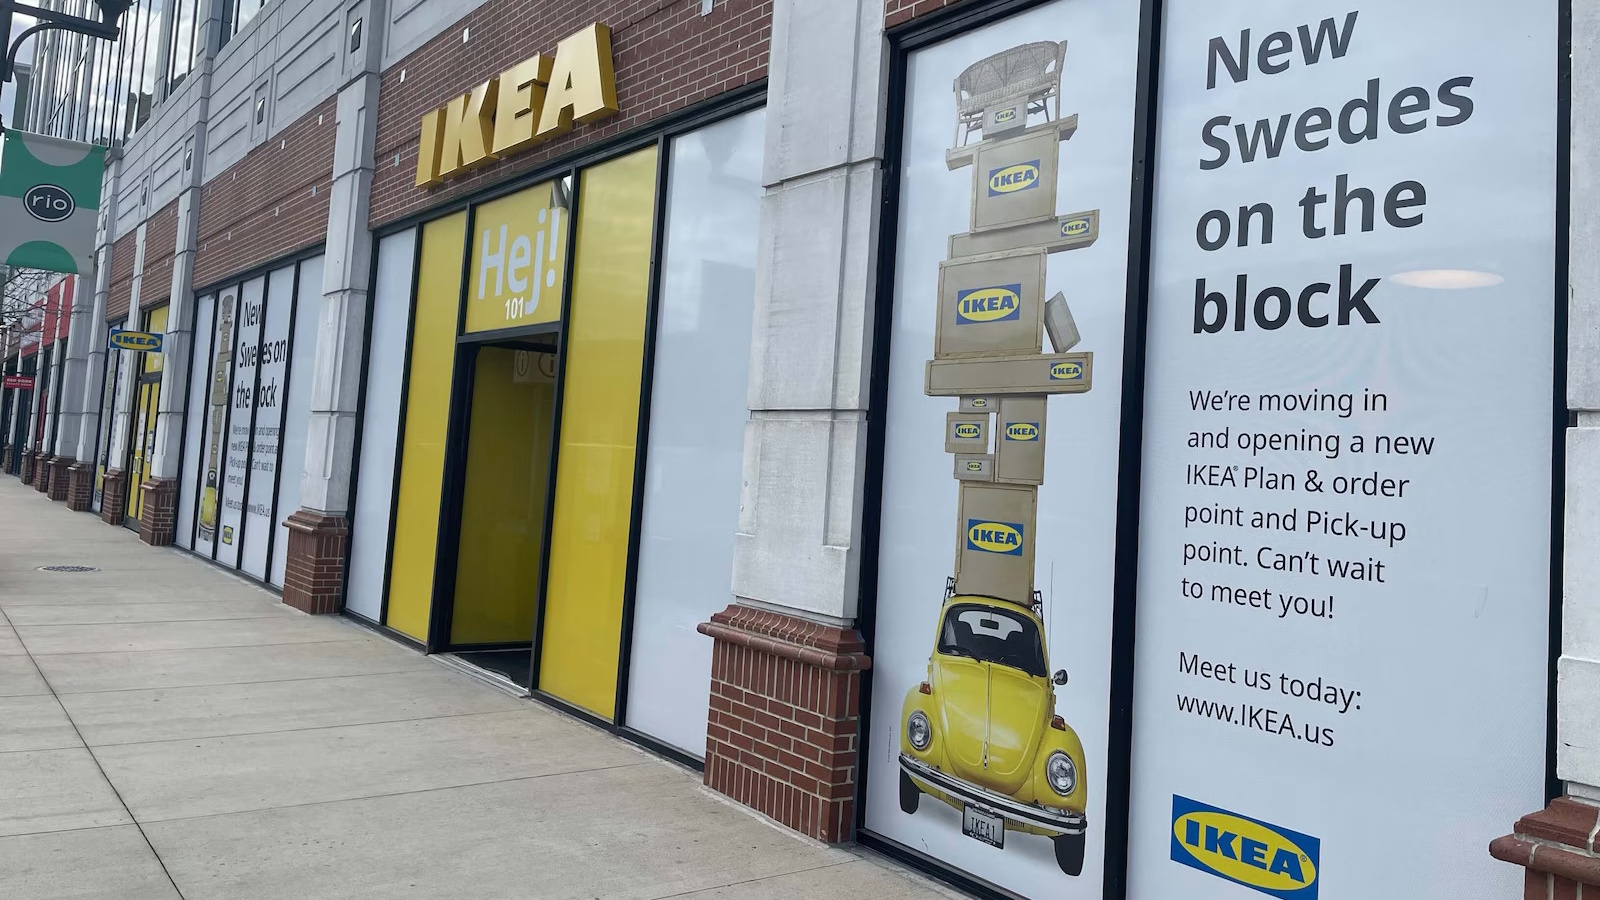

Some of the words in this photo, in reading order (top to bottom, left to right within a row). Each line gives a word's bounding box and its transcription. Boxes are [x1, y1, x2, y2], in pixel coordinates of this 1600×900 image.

[1206, 10, 1359, 90] New
[415, 22, 619, 188] IKEA
[997, 109, 1015, 120] IKEA
[1199, 76, 1474, 171] Swedes
[993, 168, 1035, 188] IKEA
[32, 194, 67, 211] rio
[1196, 202, 1274, 251] on
[1298, 173, 1427, 239] the
[1063, 222, 1087, 233] IKEA
[478, 208, 560, 315] Hej!
[505, 297, 524, 320] 101
[963, 294, 1015, 315] IKEA
[1193, 263, 1382, 334] block
[115, 335, 158, 347] IKEA
[240, 342, 273, 368] Swees
[274, 339, 286, 363] on
[1053, 366, 1080, 375] IKEA
[236, 381, 251, 409] the
[1189, 390, 1250, 411] We’re
[1259, 389, 1353, 418] moving
[1363, 388, 1387, 412] in
[957, 426, 979, 435] IKEA
[1008, 426, 1036, 436] IKEA
[1187, 427, 1229, 448] and
[1237, 429, 1340, 459] opening
[1350, 436, 1364, 453] a
[1375, 435, 1434, 455] new
[1244, 466, 1295, 491] Plan
[1304, 470, 1324, 493] &
[1333, 471, 1410, 498] order
[973, 528, 1019, 546] IKEA
[1185, 503, 1244, 528] point
[1251, 508, 1297, 531] and
[1307, 510, 1407, 548] Pick-up
[1183, 541, 1248, 566] point.
[1256, 546, 1319, 575] Can’t
[1327, 557, 1386, 583] wait
[1181, 577, 1203, 599] to
[1211, 583, 1272, 610] meet
[1278, 594, 1334, 619] you!
[1179, 651, 1236, 684] Meet
[1244, 668, 1271, 691] us
[1279, 673, 1362, 714] today:
[1177, 694, 1334, 747] www.IKEA.us
[971, 816, 995, 841] IKEA1
